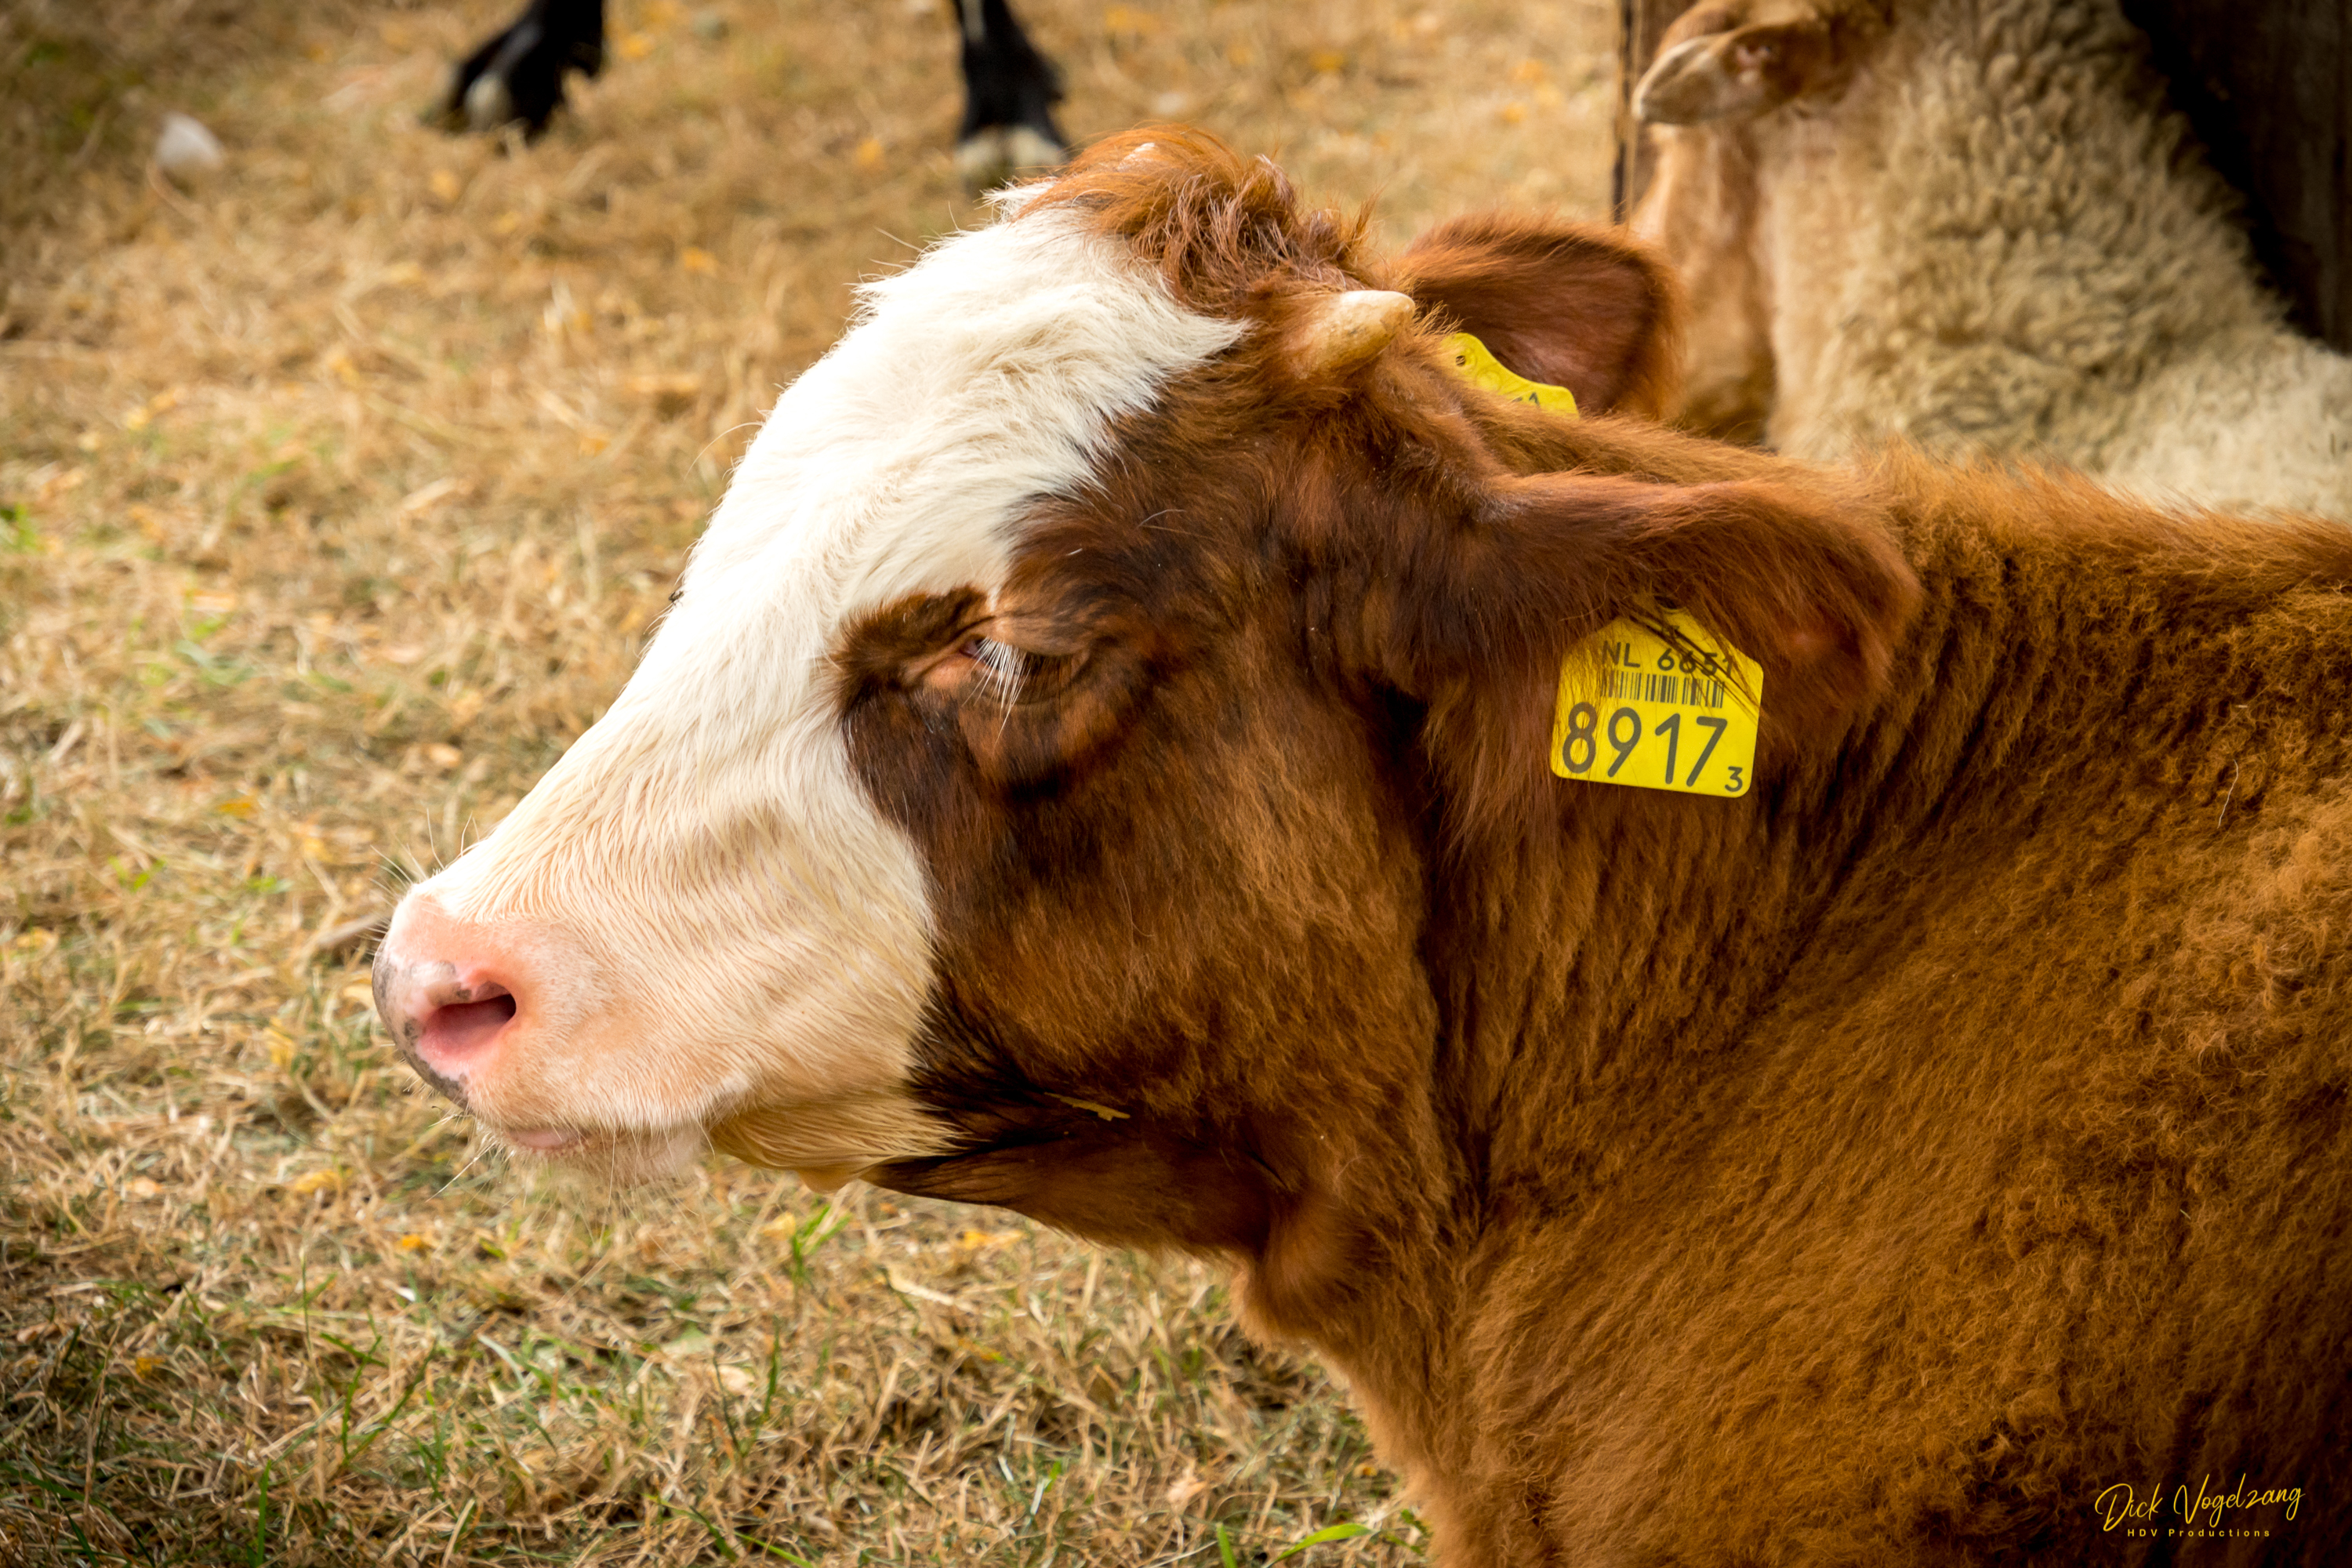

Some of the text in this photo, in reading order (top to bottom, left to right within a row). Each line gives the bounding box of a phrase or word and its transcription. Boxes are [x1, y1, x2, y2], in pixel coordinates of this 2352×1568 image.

[1602, 640, 1641, 668] NL
[1562, 701, 1728, 787] 8917
[1724, 765, 1744, 793] 3
